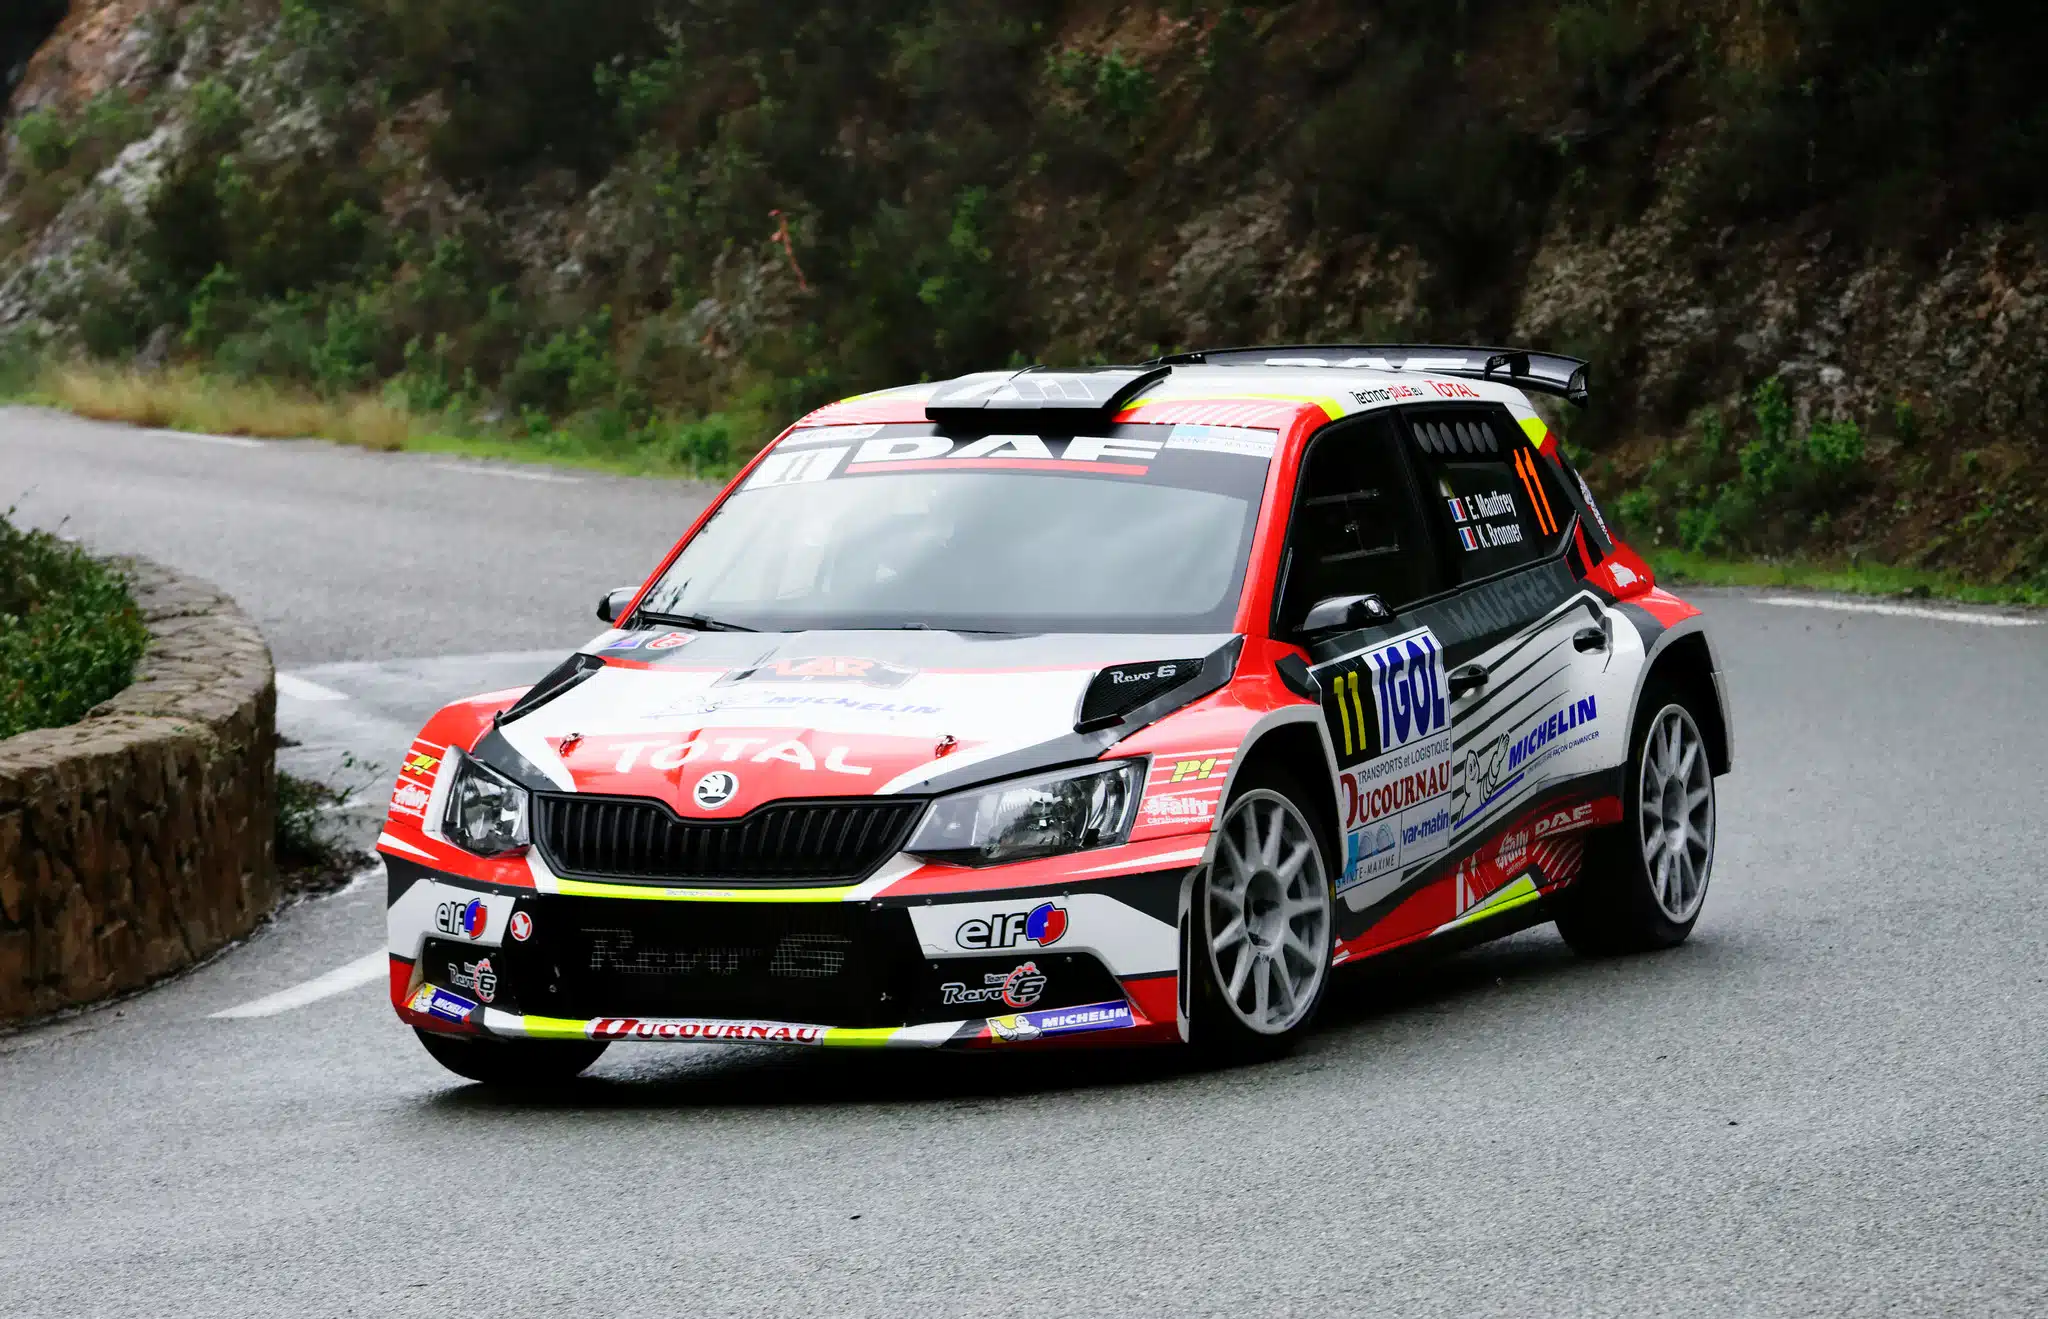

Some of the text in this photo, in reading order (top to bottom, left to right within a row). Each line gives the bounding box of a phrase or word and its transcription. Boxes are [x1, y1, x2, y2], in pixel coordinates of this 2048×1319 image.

[1349, 384, 1423, 405] Techno-plus.eu
[1424, 380, 1480, 398] TOTAL
[851, 434, 1165, 463] DAF
[1465, 496, 1480, 520] E.
[1513, 446, 1558, 536] 11
[1475, 523, 1523, 548] K. Bronner
[1110, 664, 1177, 684] Revo 6
[1372, 635, 1445, 749] IGOL
[1333, 670, 1367, 756] 11
[1507, 695, 1597, 772] MICHELIN
[607, 737, 873, 776] TOTAL
[1357, 738, 1450, 785] TRANSPORTS et LOGISTIQUE
[1339, 759, 1451, 830] DUCOURNAU
[1402, 808, 1449, 846] var-matin
[1534, 803, 1593, 838] DAF
[435, 901, 468, 936] elf
[956, 911, 1029, 950] elf
[941, 983, 1012, 1005] Revo
[591, 1017, 819, 1044] DUCOURNAU
[1040, 1007, 1129, 1030] MICHELIN
